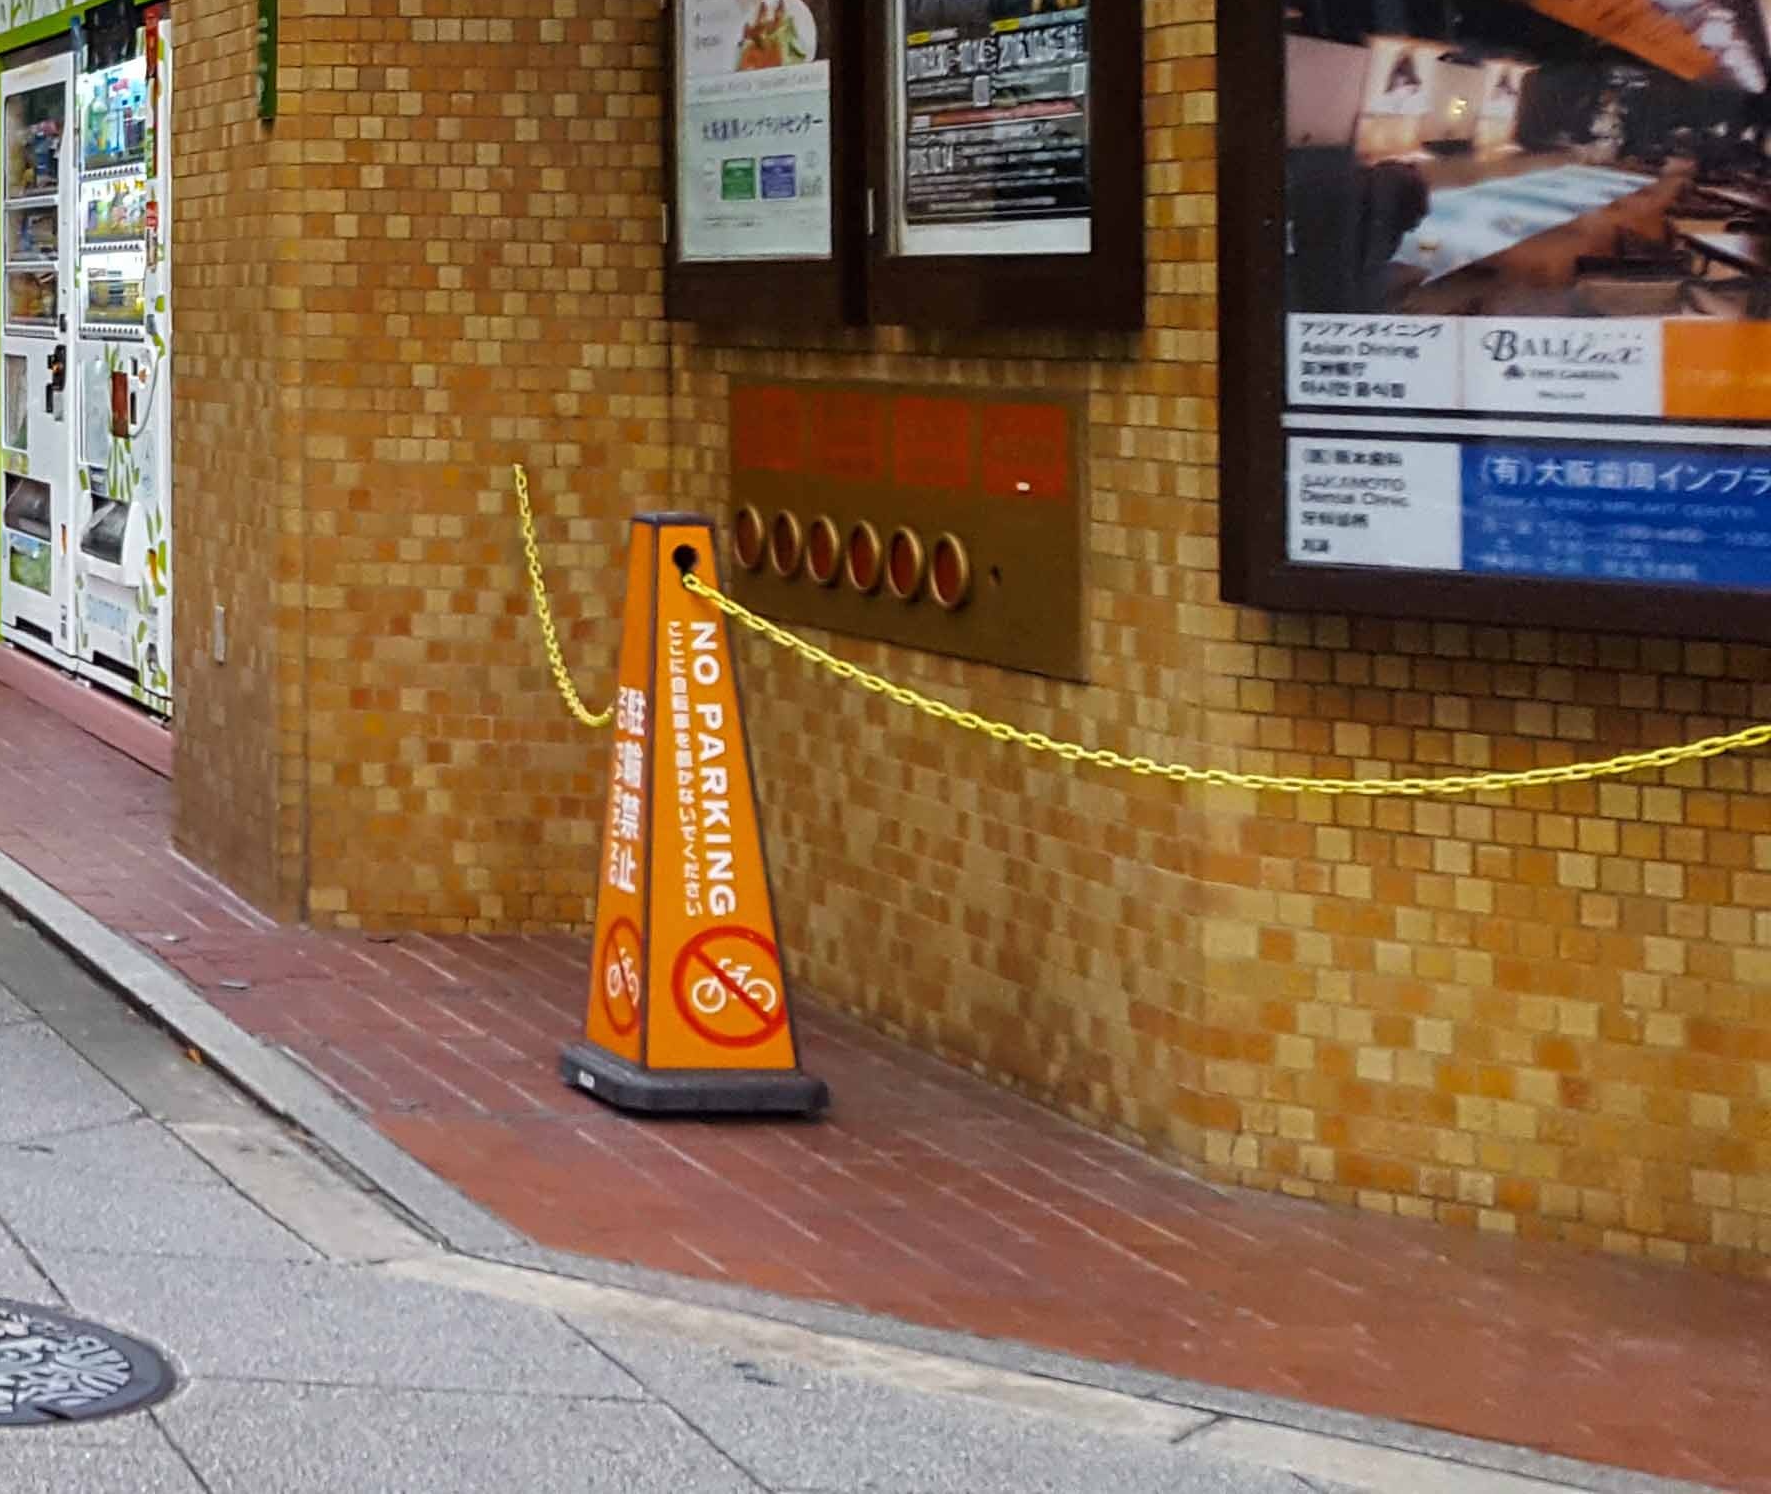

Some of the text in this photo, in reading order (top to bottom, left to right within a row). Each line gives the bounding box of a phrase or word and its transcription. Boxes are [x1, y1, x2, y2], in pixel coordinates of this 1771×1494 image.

[1299, 321, 1444, 338] アジアンダイニング
[1300, 340, 1421, 359] Asian Dining
[689, 621, 737, 918] NO PARKING
[608, 740, 625, 886] PARKING
